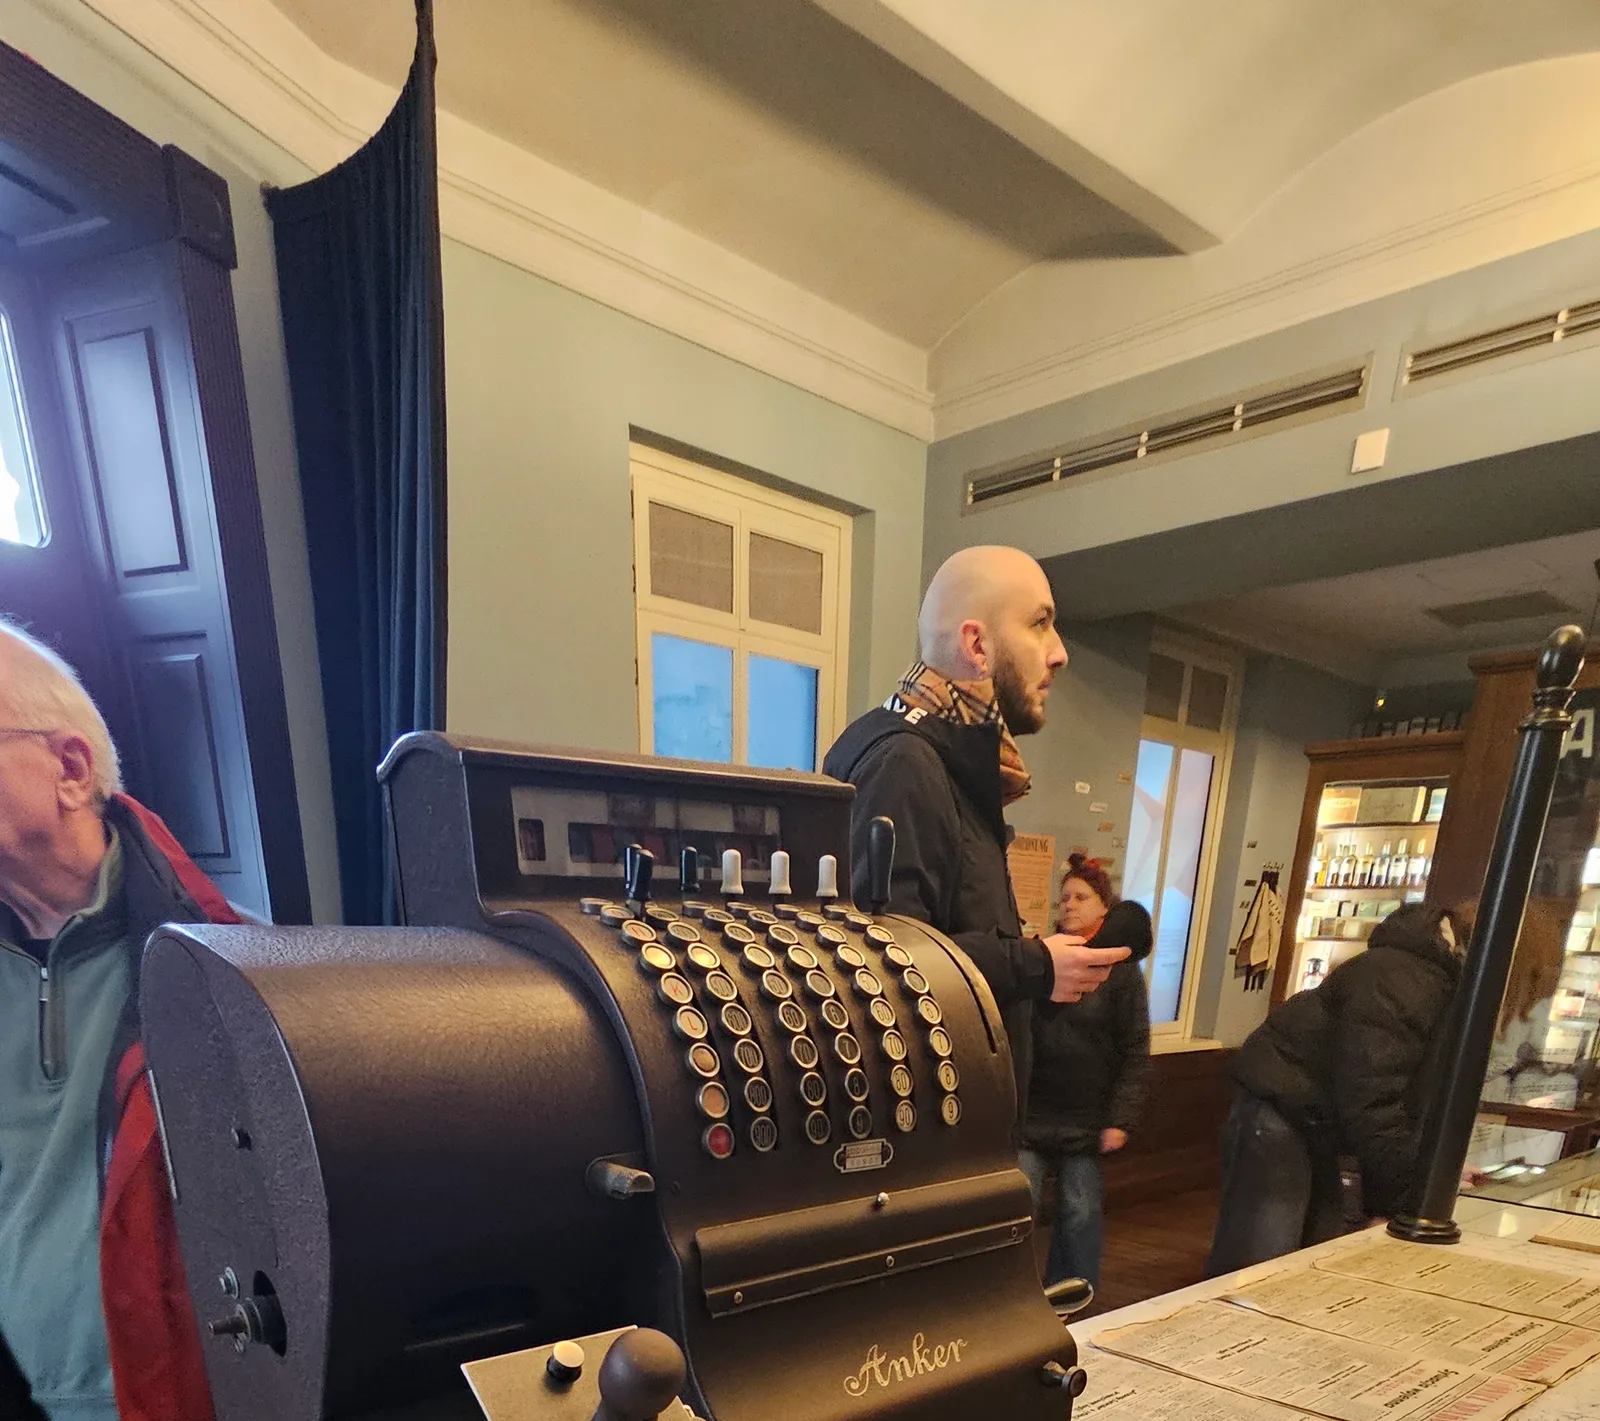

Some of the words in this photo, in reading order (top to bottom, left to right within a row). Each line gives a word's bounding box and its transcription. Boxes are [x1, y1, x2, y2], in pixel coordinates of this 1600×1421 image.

[786, 1007, 800, 1027] 60
[831, 1007, 839, 1027] 6
[876, 1005, 891, 1022] 60
[926, 1003, 935, 1019] 6
[687, 1017, 698, 1031] L
[797, 1042, 809, 1063] 70
[843, 1040, 851, 1060] 7
[888, 1036, 901, 1056] 70
[936, 1034, 944, 1051] 7
[740, 1046, 759, 1067] 700
[853, 1077, 861, 1096] 8
[895, 1072, 909, 1091] 80
[944, 1067, 951, 1086] 8
[807, 1080, 821, 1101] 80
[899, 1107, 912, 1127] 90
[947, 1101, 954, 1119] 9
[856, 1113, 864, 1133] 9
[843, 1332, 968, 1396] Anker
